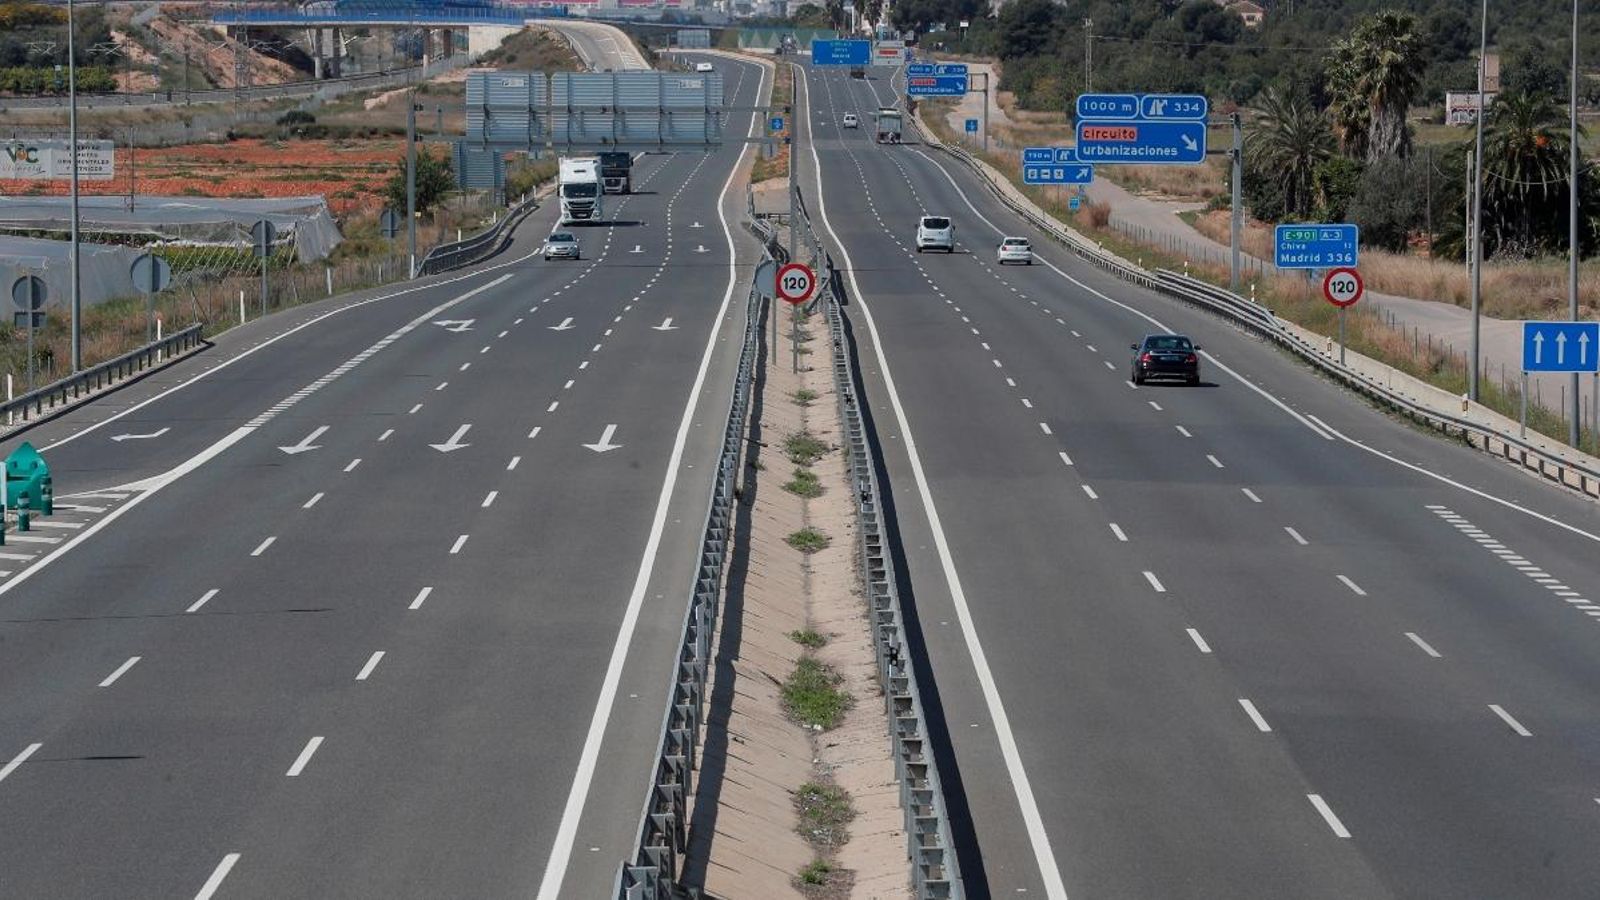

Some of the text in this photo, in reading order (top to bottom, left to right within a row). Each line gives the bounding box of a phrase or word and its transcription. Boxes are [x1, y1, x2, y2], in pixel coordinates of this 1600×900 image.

[1084, 101, 1116, 111] 1000
[1174, 103, 1200, 112] 334
[1083, 128, 1136, 139] circuito
[1082, 145, 1178, 156] urbanizaciones
[1285, 231, 1315, 240] E-901
[1322, 231, 1340, 239] A-3
[1281, 253, 1353, 263] Madrid 336
[783, 277, 807, 290] 120
[1331, 280, 1355, 294] 120
